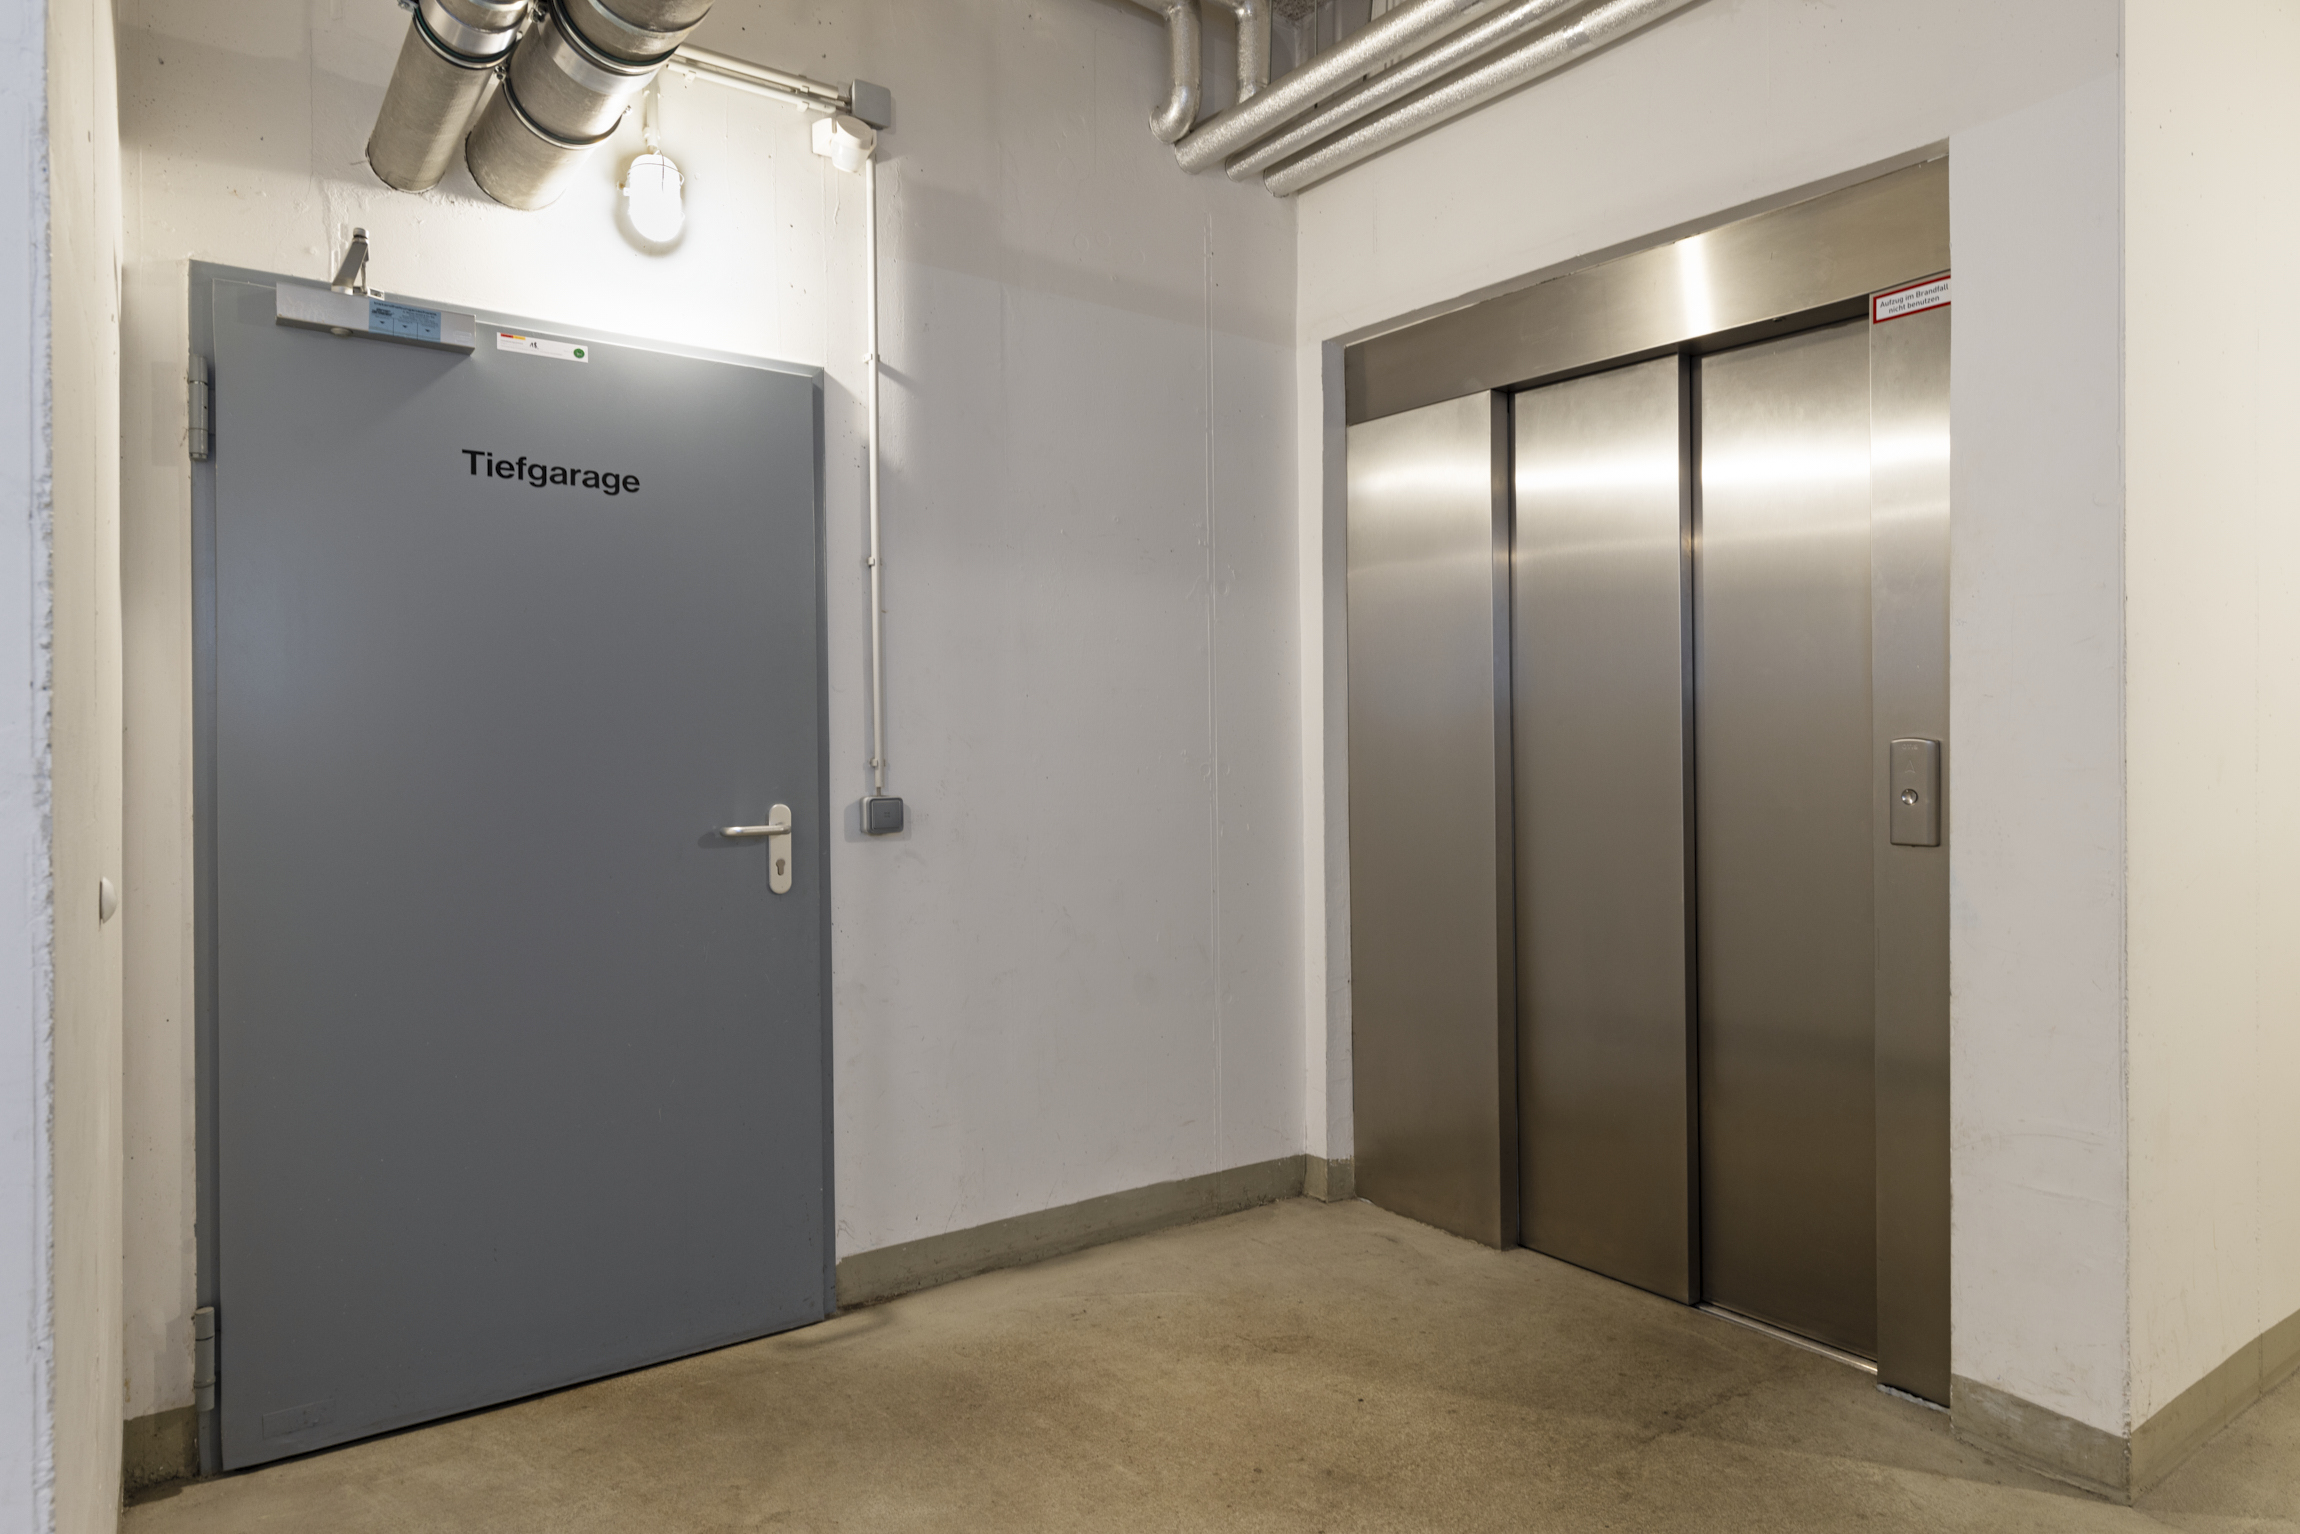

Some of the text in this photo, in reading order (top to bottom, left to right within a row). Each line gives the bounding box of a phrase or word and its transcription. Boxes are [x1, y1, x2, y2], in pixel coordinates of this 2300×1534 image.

[1880, 296, 1904, 308] Aufzug
[1915, 283, 1949, 298] Brandfall
[1888, 295, 1940, 314] nicht benutzen
[462, 449, 640, 496] Tiefgarage
